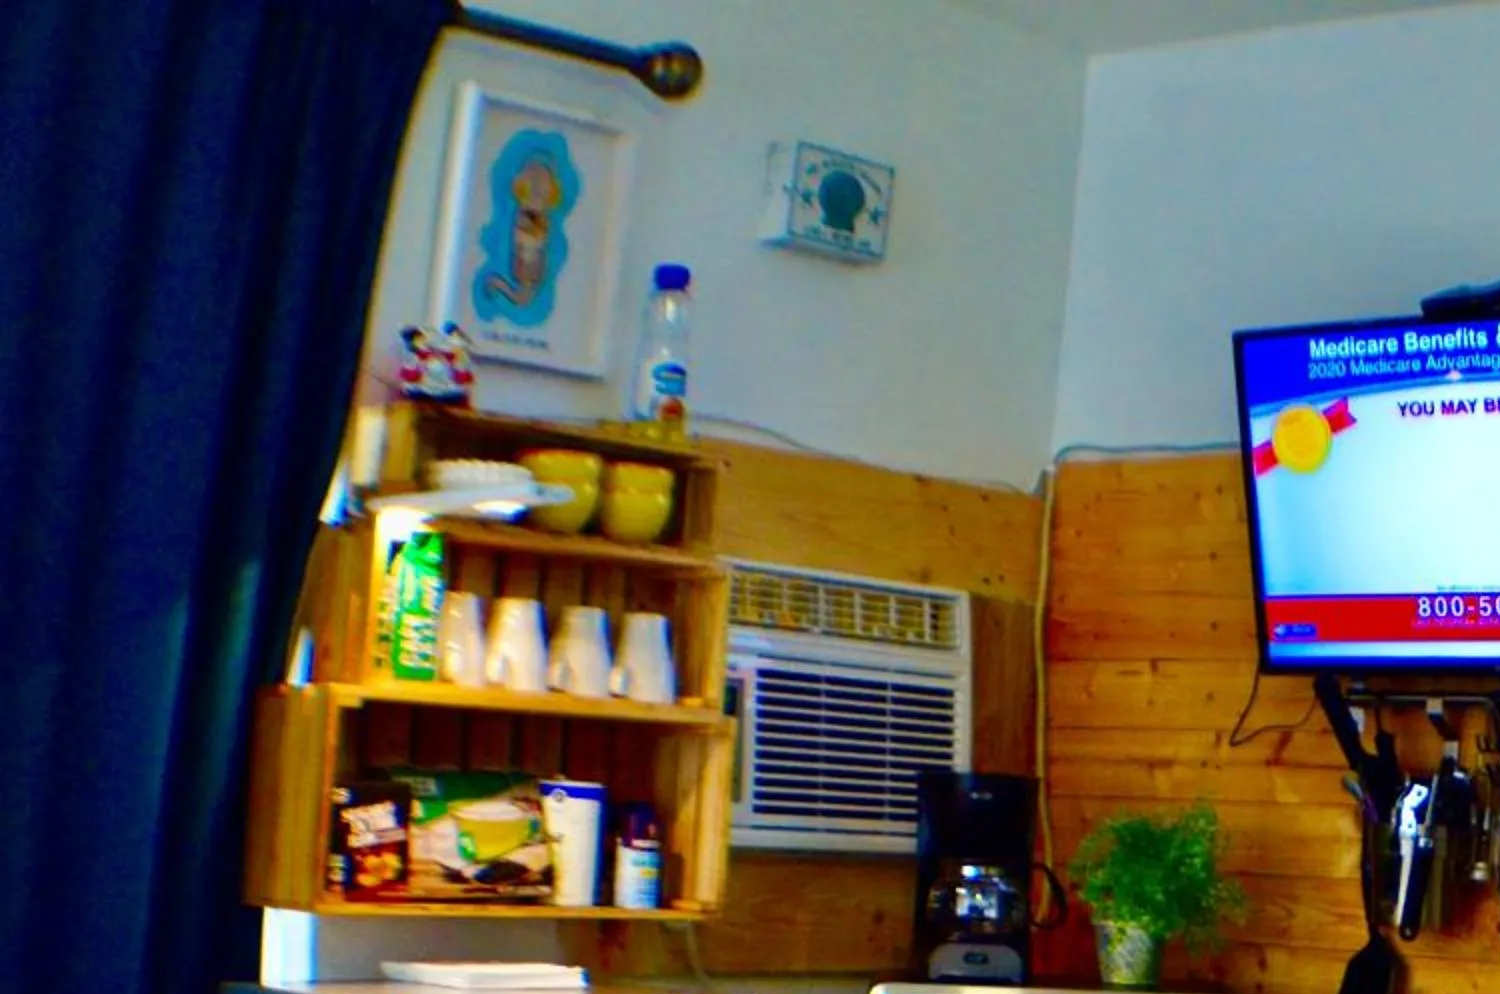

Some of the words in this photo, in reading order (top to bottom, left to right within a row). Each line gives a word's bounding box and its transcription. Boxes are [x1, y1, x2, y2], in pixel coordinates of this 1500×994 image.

[1309, 336, 1398, 359] Medicare
[1403, 327, 1488, 353] Benefits
[1308, 361, 1346, 379] 2020
[1351, 358, 1421, 376] Medicare
[1397, 401, 1434, 417] YOU
[1441, 399, 1478, 415] MAY
